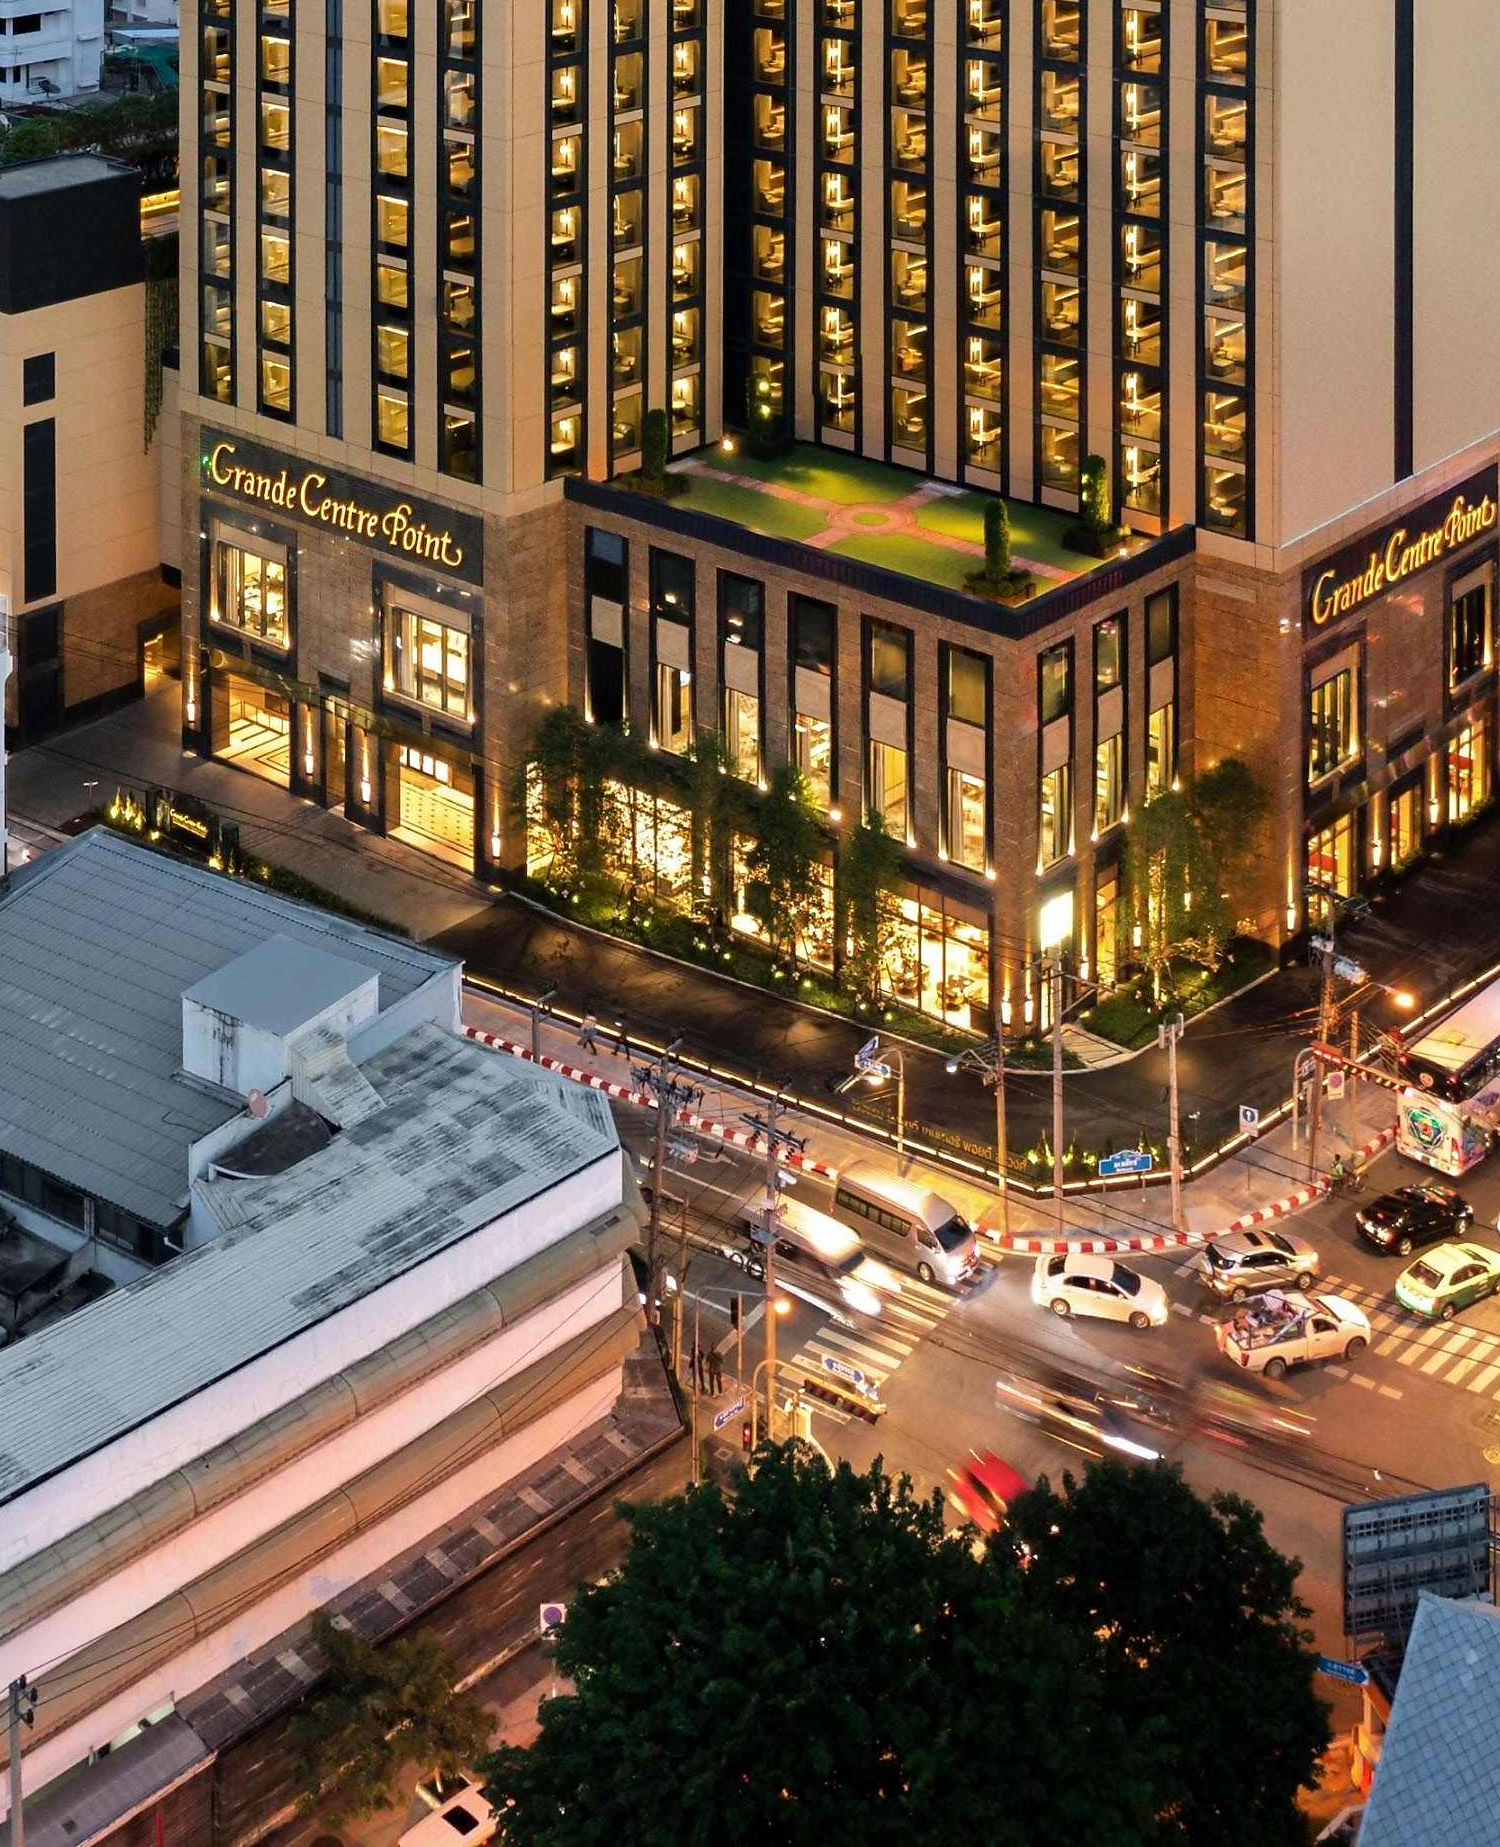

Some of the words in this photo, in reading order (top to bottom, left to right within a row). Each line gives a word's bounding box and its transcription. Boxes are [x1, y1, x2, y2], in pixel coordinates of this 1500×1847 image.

[211, 443, 298, 509] Grande
[300, 474, 379, 537] Centre
[382, 504, 463, 567] Point
[1312, 553, 1384, 624] Grande
[1385, 528, 1443, 582] Centre
[1445, 494, 1497, 548] Point
